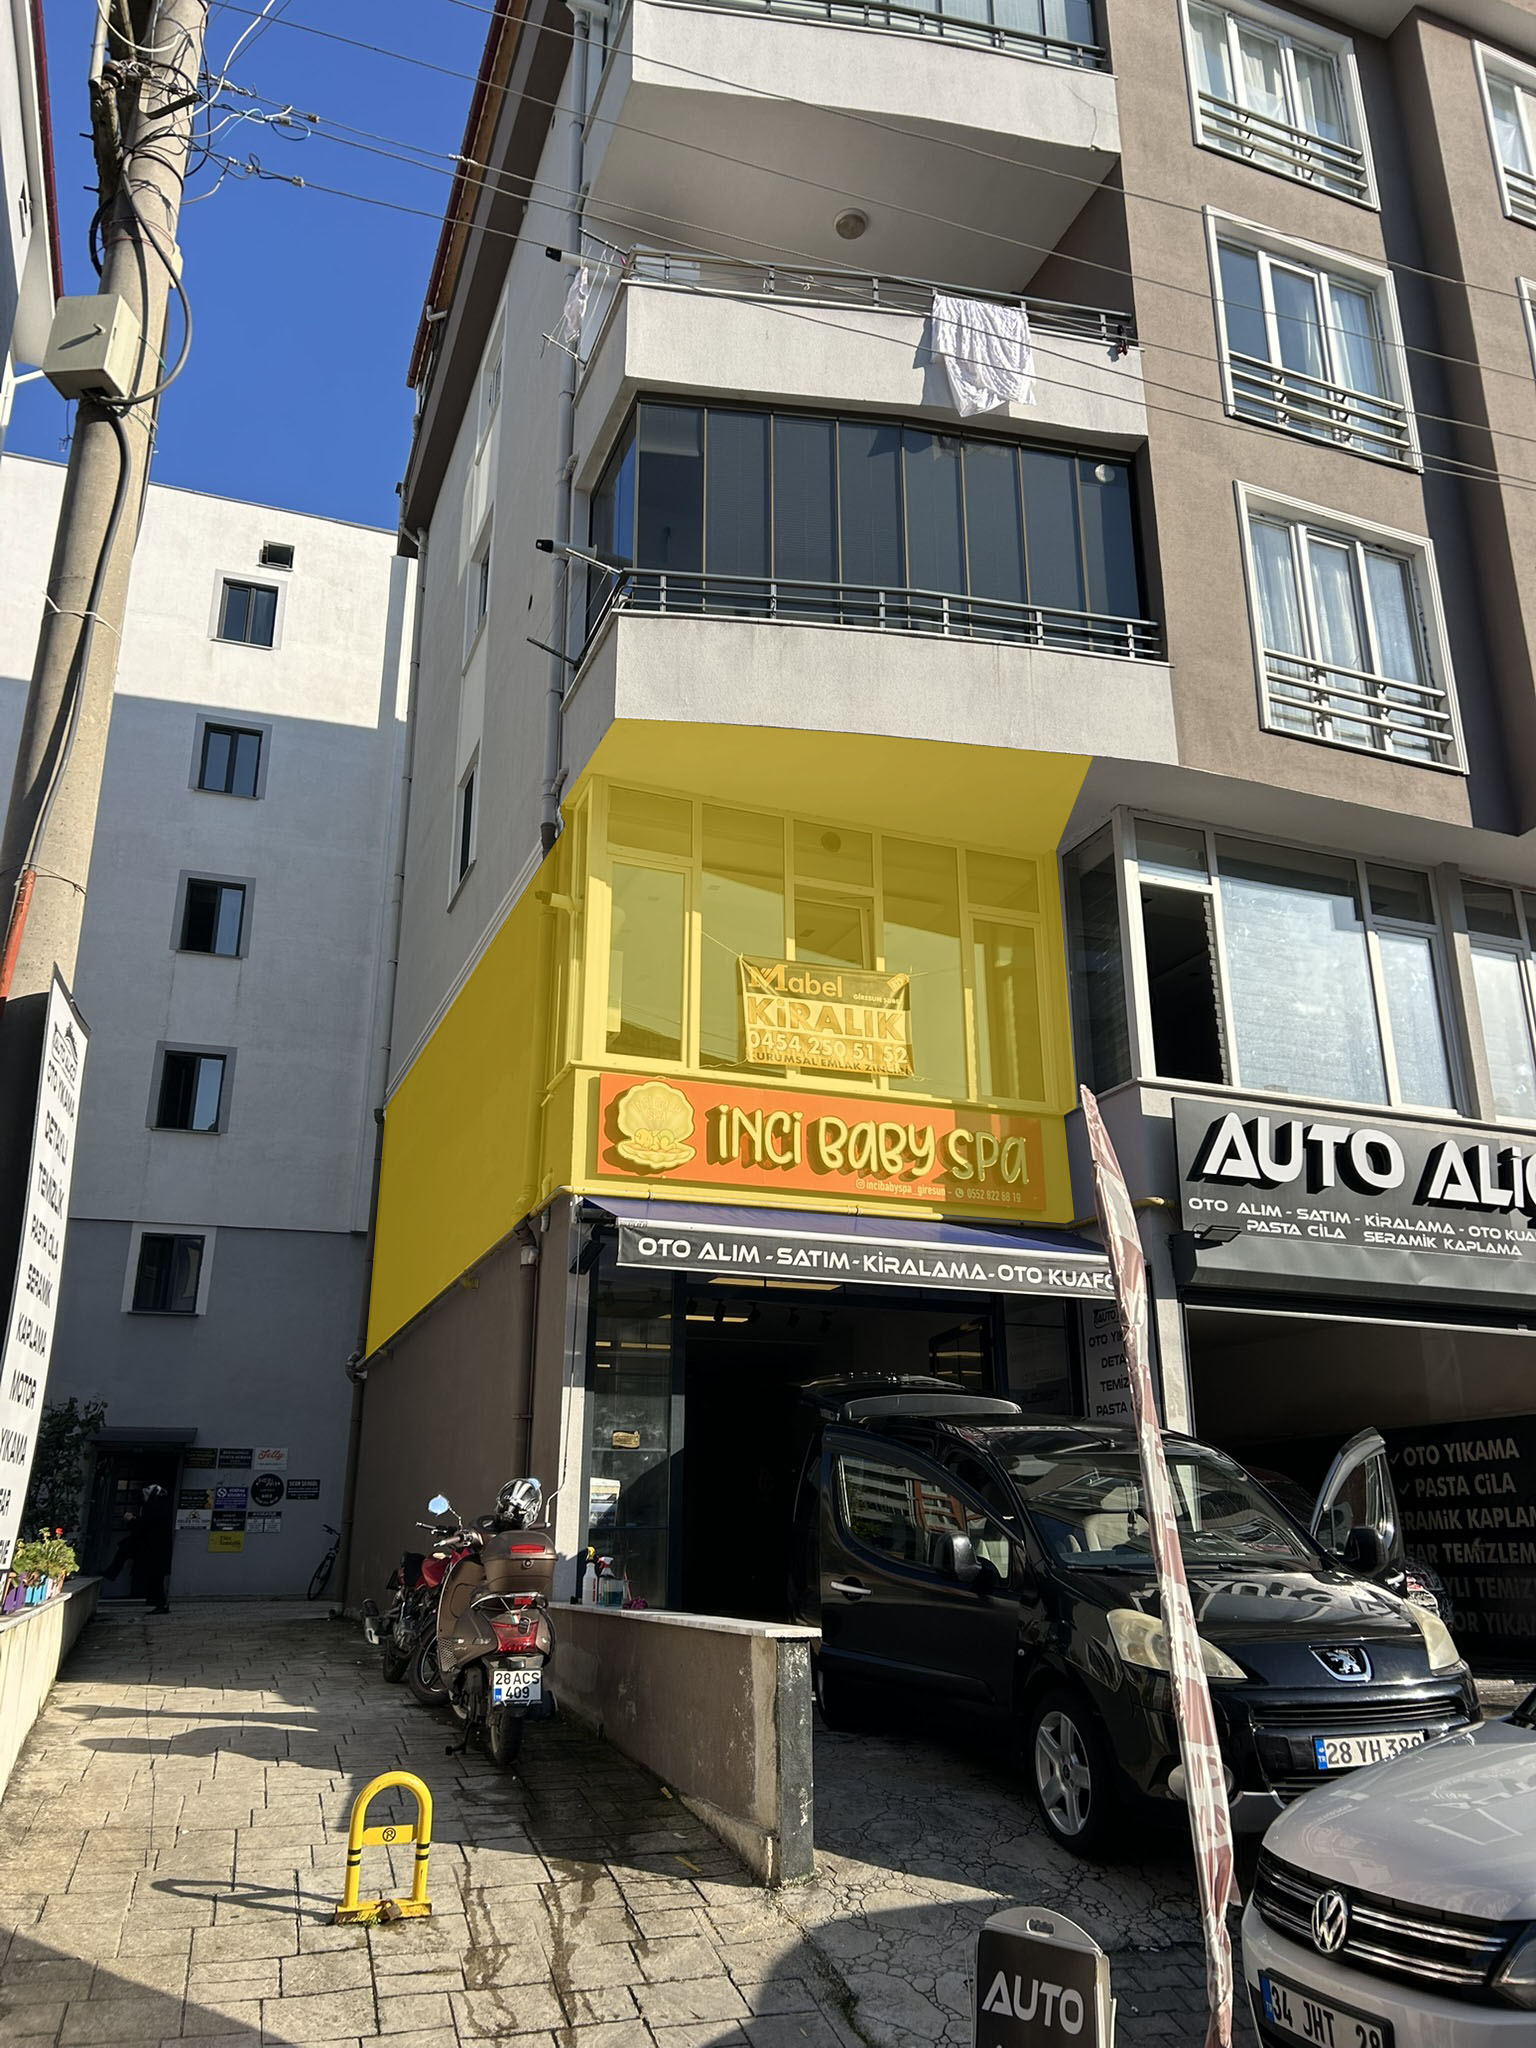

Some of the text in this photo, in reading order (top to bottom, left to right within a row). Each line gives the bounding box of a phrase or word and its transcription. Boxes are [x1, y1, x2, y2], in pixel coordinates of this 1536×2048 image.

[748, 964, 843, 998] Mabel
[749, 1030, 908, 1064] 0454 250 51 52
[1202, 1111, 1406, 1190] AUTO
[1188, 1197, 1229, 1213] OTO
[1236, 1201, 1282, 1219] ALIM
[1296, 1208, 1351, 1226] SATIM
[1468, 1225, 1502, 1240] OTO
[638, 1236, 691, 1259] OTO
[697, 1241, 761, 1264] ALIM
[1247, 1218, 1302, 1236] PASTA
[1443, 1238, 1523, 1256] KAPLAMA
[1088, 1333, 1108, 1348] OTO
[9, 1368, 37, 1410] MOTOR
[1403, 1437, 1520, 1467] OTO YIKAMA
[1415, 1475, 1471, 1498] PASTA
[495, 1672, 540, 1685] 28 ACS
[505, 1686, 530, 1699] 409
[1326, 1741, 1353, 1765] 28
[1356, 1739, 1383, 1763] YH
[981, 1970, 1084, 2035] AUTO
[1271, 1985, 1293, 2028] 34
[1303, 2000, 1335, 2048] JHT
